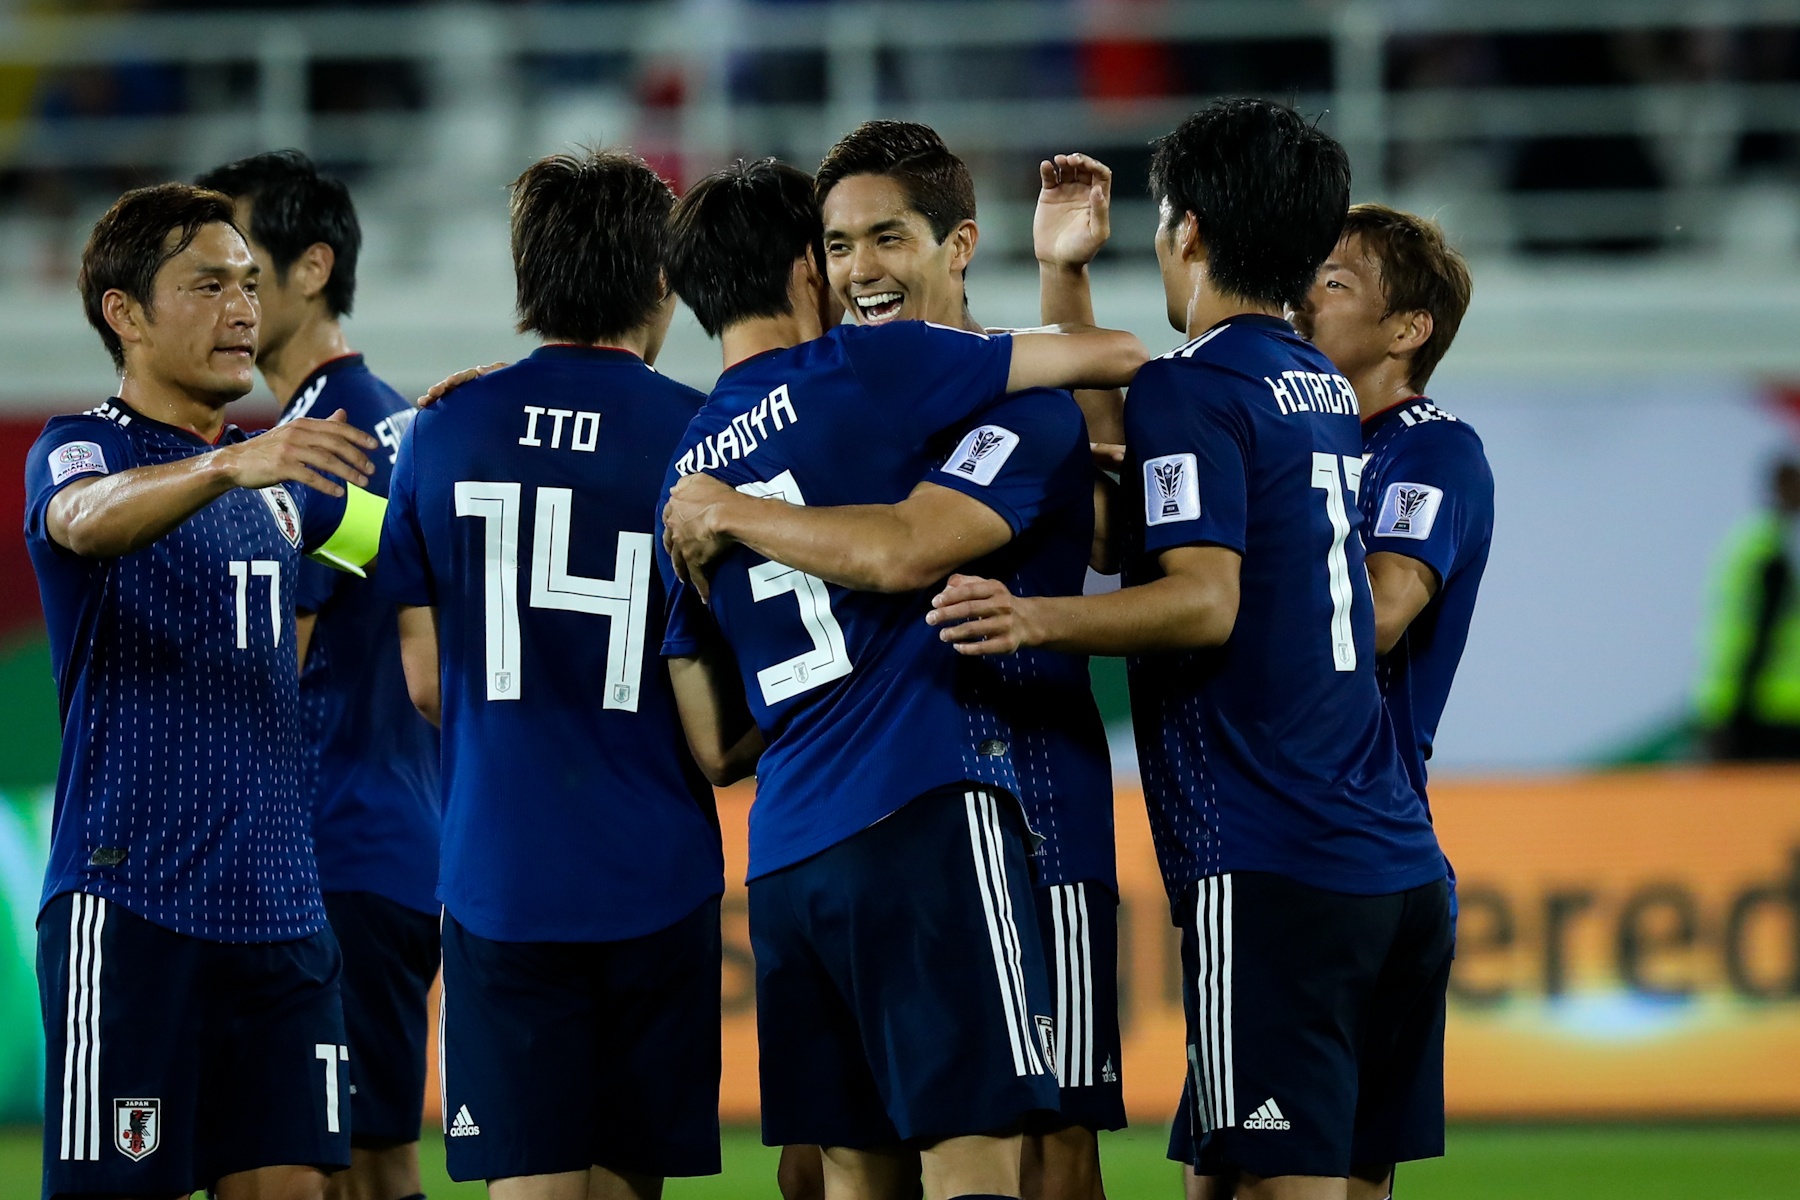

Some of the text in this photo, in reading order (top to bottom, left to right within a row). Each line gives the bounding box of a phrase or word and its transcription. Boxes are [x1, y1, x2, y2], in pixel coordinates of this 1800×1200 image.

[1264, 371, 1360, 415] KITAGA
[519, 405, 601, 452] ITO
[229, 560, 280, 649] 17
[455, 481, 652, 712] 14
[735, 469, 853, 707] 3
[1450, 842, 1800, 1010] ered
[127, 1141, 146, 1149] JFA
[450, 1124, 480, 1137] adidas
[1243, 1118, 1291, 1130] adidas
